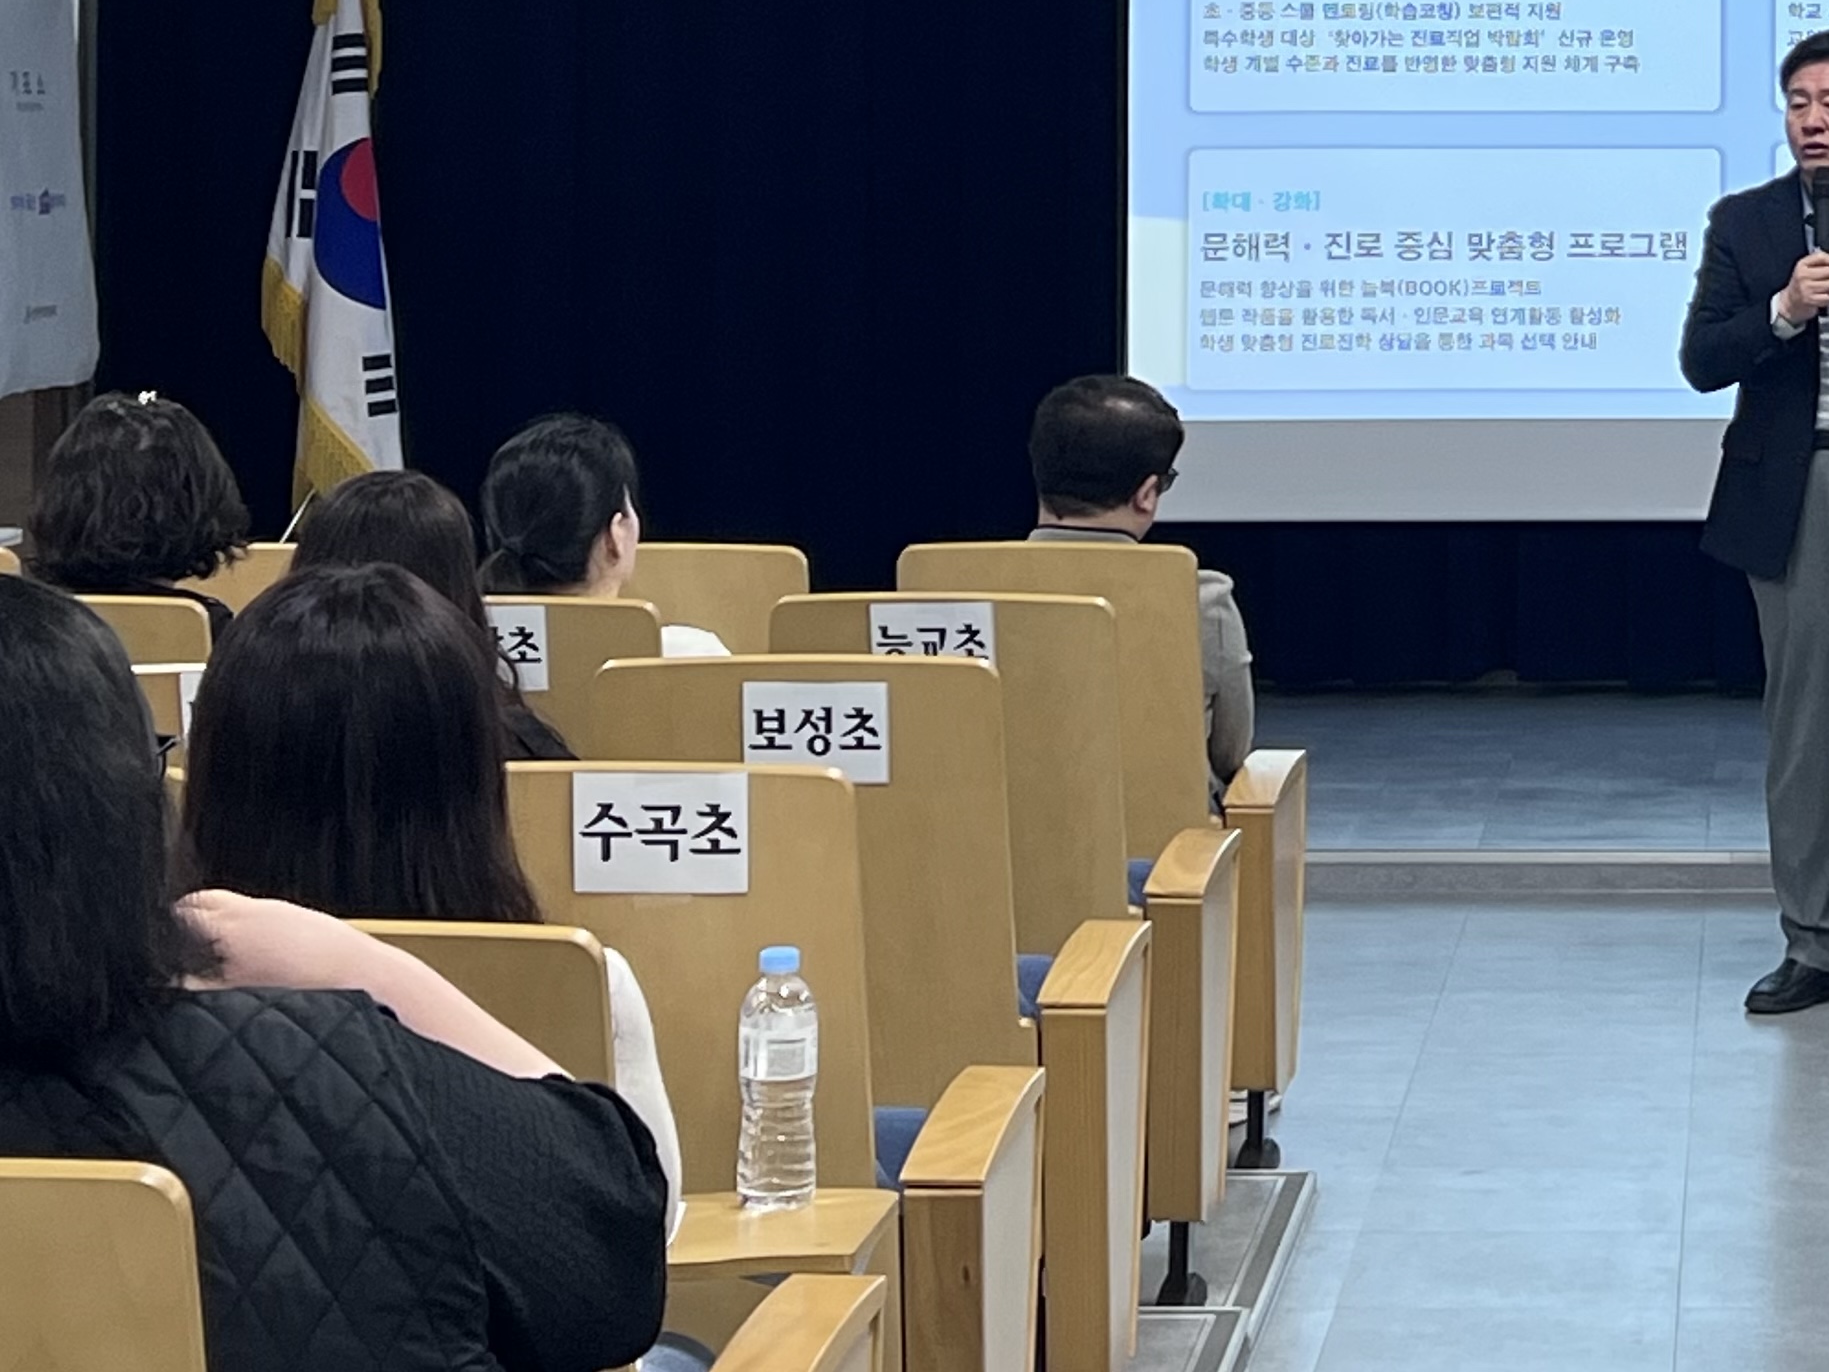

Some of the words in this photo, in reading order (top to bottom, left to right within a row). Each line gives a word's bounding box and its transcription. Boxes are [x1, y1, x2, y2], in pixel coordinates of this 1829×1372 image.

[1527, 1, 1562, 21] 지원
[1788, 3, 1821, 21] 학교
[1280, 29, 1314, 49] 대상
[1558, 29, 1592, 49] 신규
[1204, 54, 1237, 73] 학생
[1522, 54, 1556, 73] 지원
[1201, 230, 1290, 262] 문해력
[1325, 230, 1384, 262] 진로
[1394, 230, 1453, 262] 중심
[1467, 230, 1556, 262] 맞춤형
[1566, 230, 1688, 262] 프로그램
[494, 625, 542, 664] 초
[748, 707, 882, 757] 보성초
[579, 801, 742, 862] 수곡초
